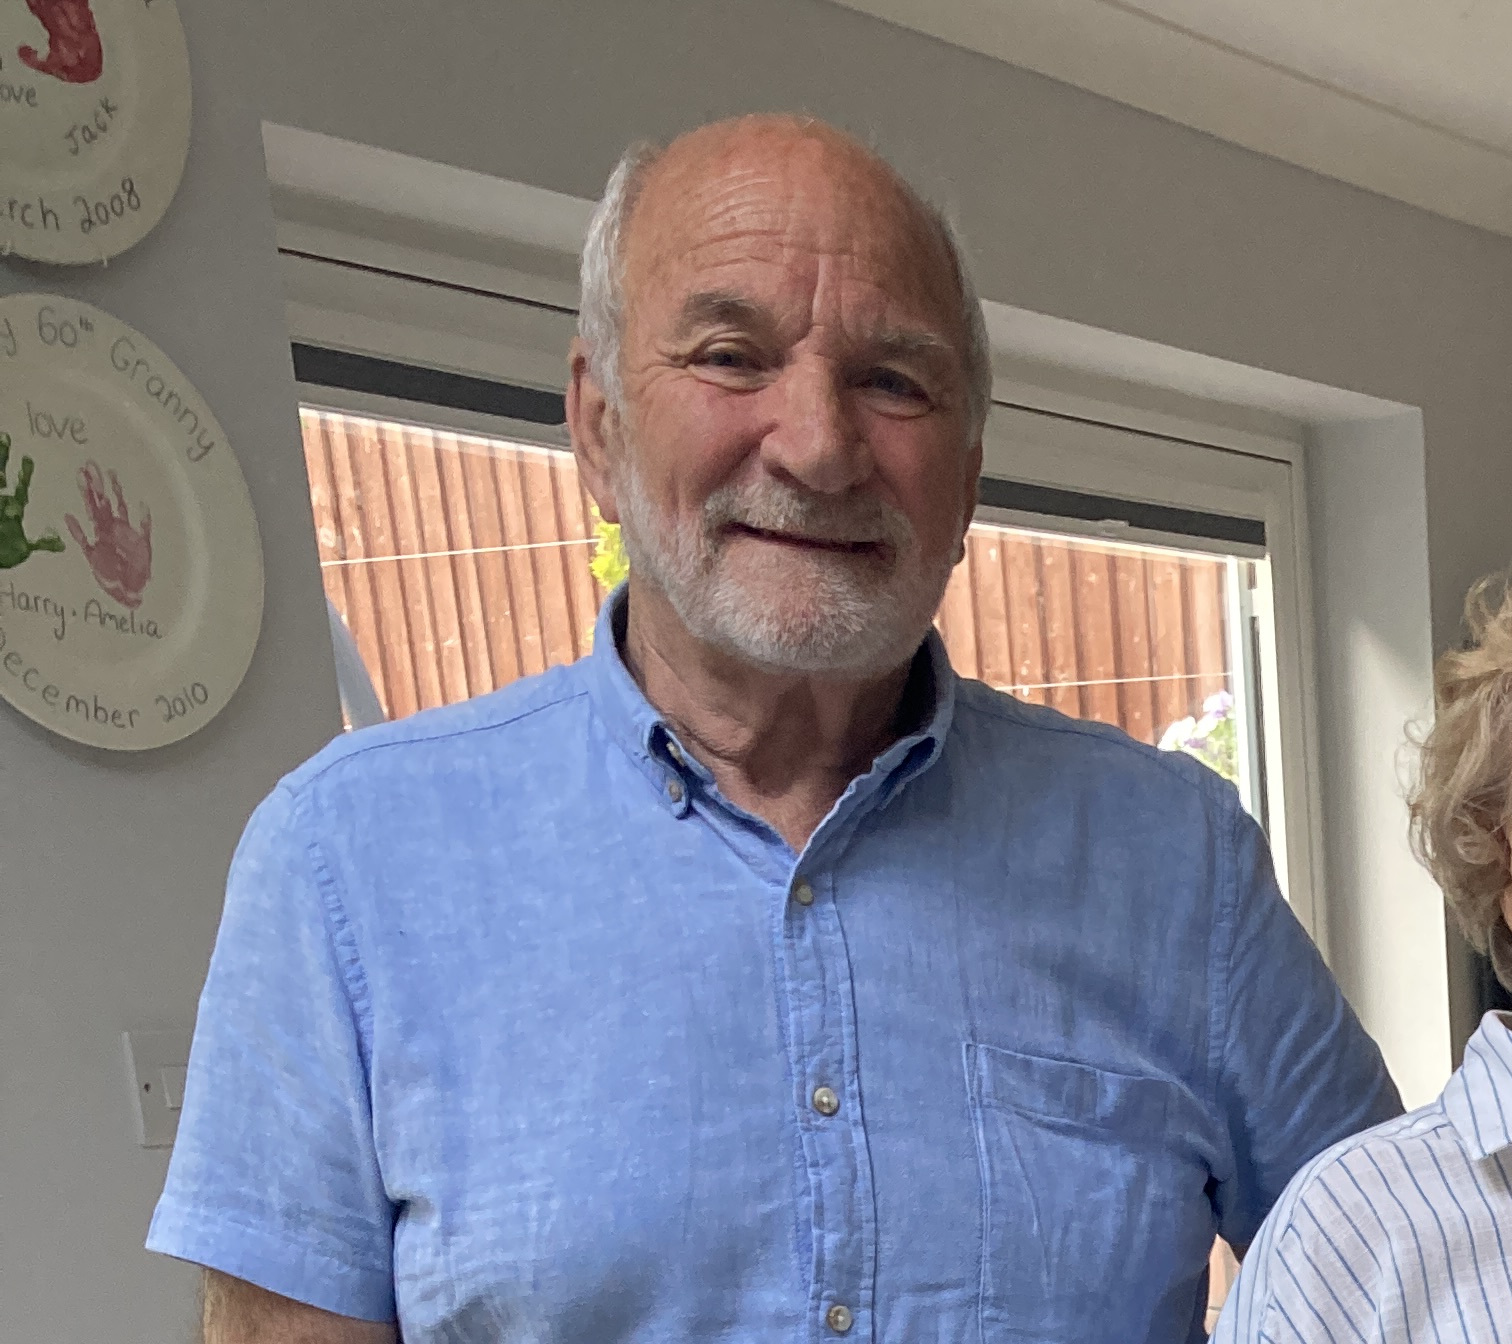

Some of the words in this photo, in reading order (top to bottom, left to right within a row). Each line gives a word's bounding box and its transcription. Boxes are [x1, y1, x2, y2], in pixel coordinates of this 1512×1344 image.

[65, 97, 118, 156] Jack
[0, 196, 60, 232] rch
[73, 177, 141, 234] 2008
[27, 401, 88, 444] love
[110, 335, 215, 463] Granny
[84, 598, 163, 640] Amelia
[155, 682, 209, 723] 2010
